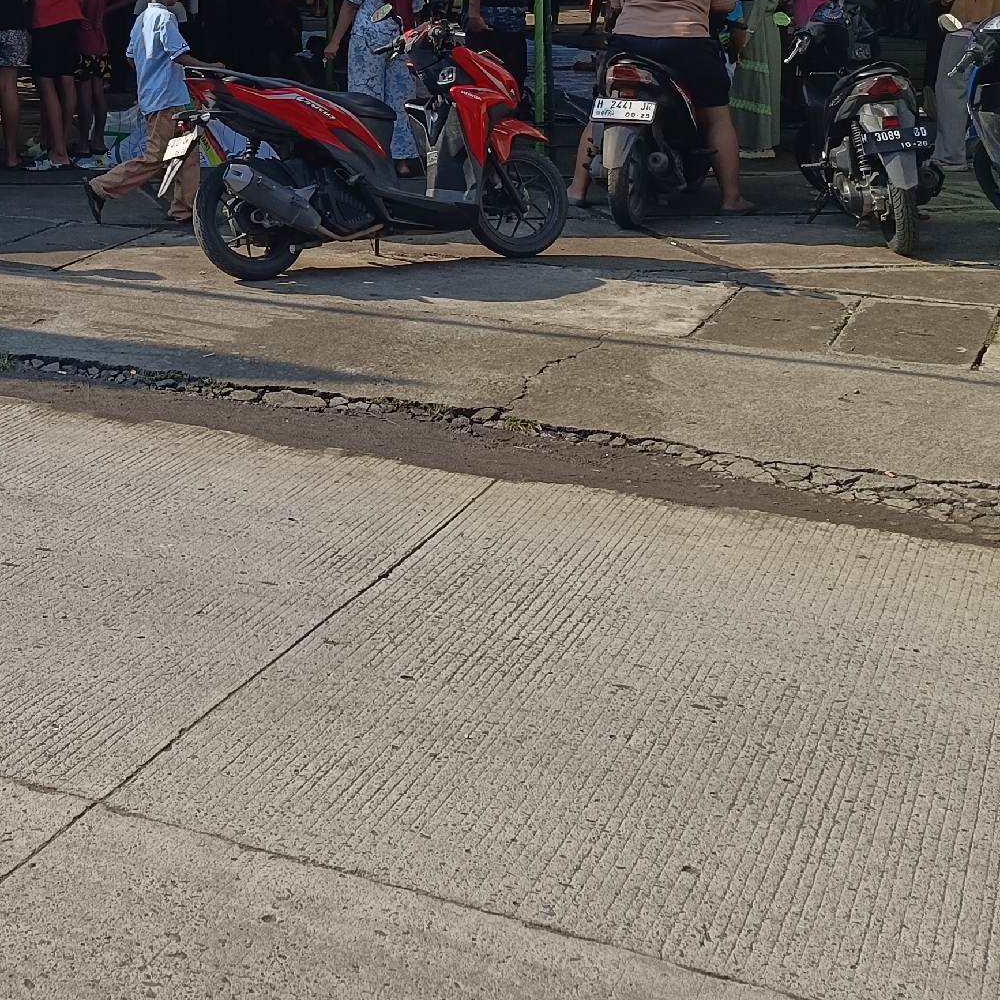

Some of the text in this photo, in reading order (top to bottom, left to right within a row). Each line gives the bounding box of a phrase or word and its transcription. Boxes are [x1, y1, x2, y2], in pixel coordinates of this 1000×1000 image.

[597, 100, 604, 109] H
[611, 100, 632, 110] 2441
[861, 133, 867, 142] H
[875, 130, 900, 141] 3089
